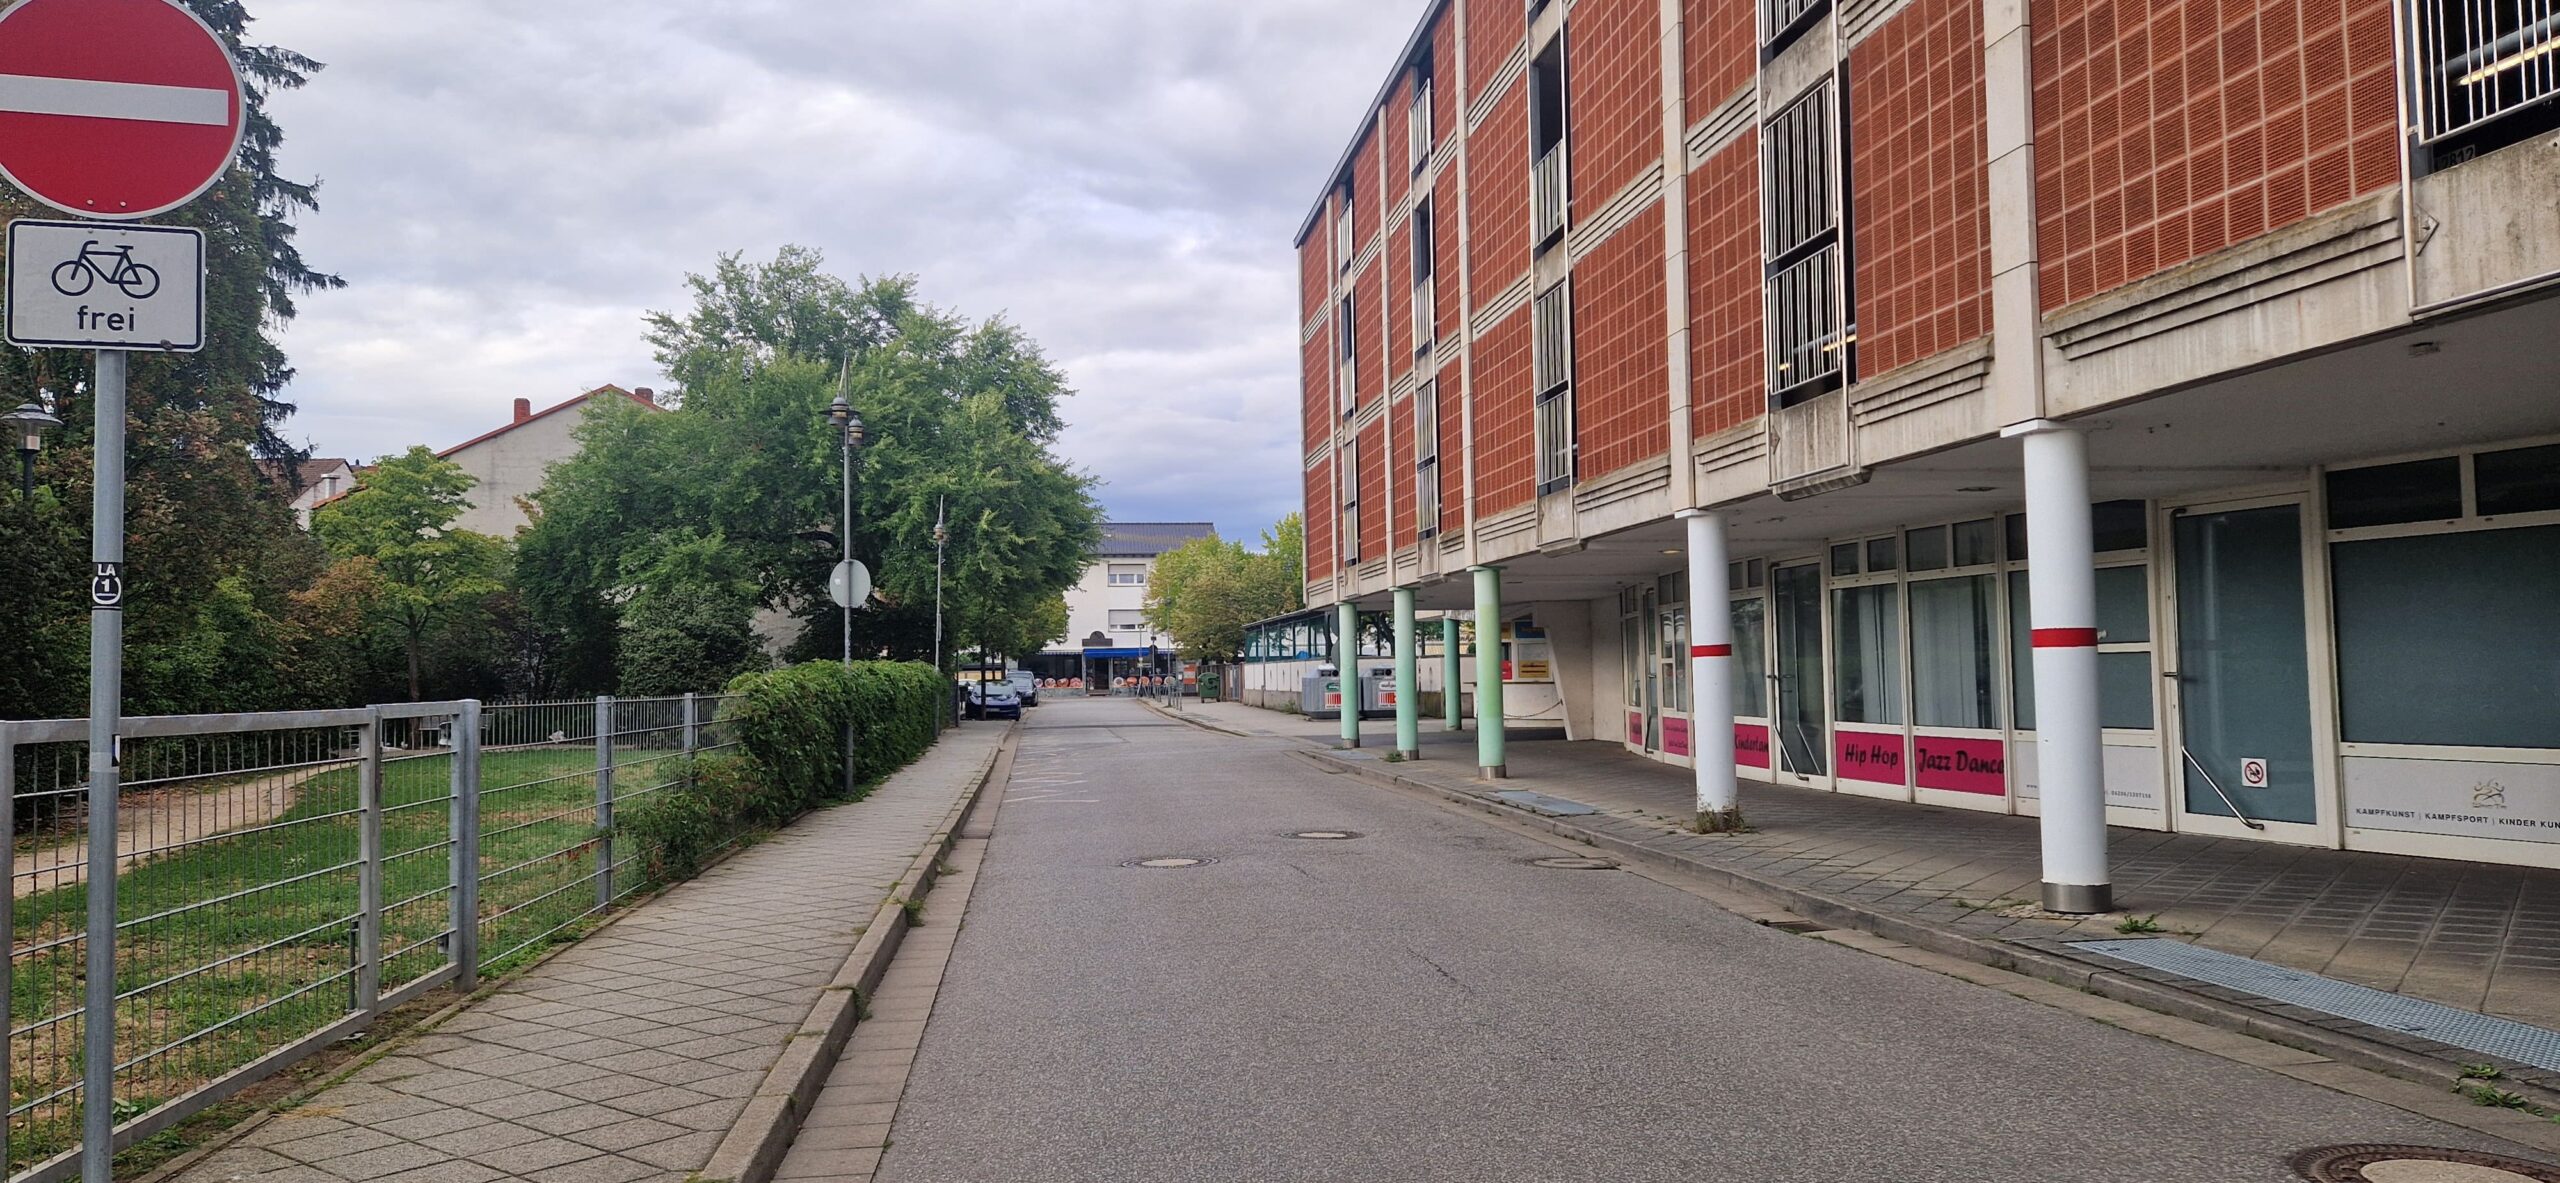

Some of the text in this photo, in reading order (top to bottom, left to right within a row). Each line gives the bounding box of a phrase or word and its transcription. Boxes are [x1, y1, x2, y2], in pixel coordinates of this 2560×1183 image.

[77, 305, 135, 332] frei
[97, 563, 116, 576] LA
[101, 578, 110, 592] 1
[1845, 743, 1898, 770] Hip Hop
[1918, 748, 1951, 773] Jazz
[2356, 808, 2415, 818] KAMPFKUNST
[2425, 813, 2488, 824] KAMPFSPORT
[2498, 817, 2536, 827] KINDER
